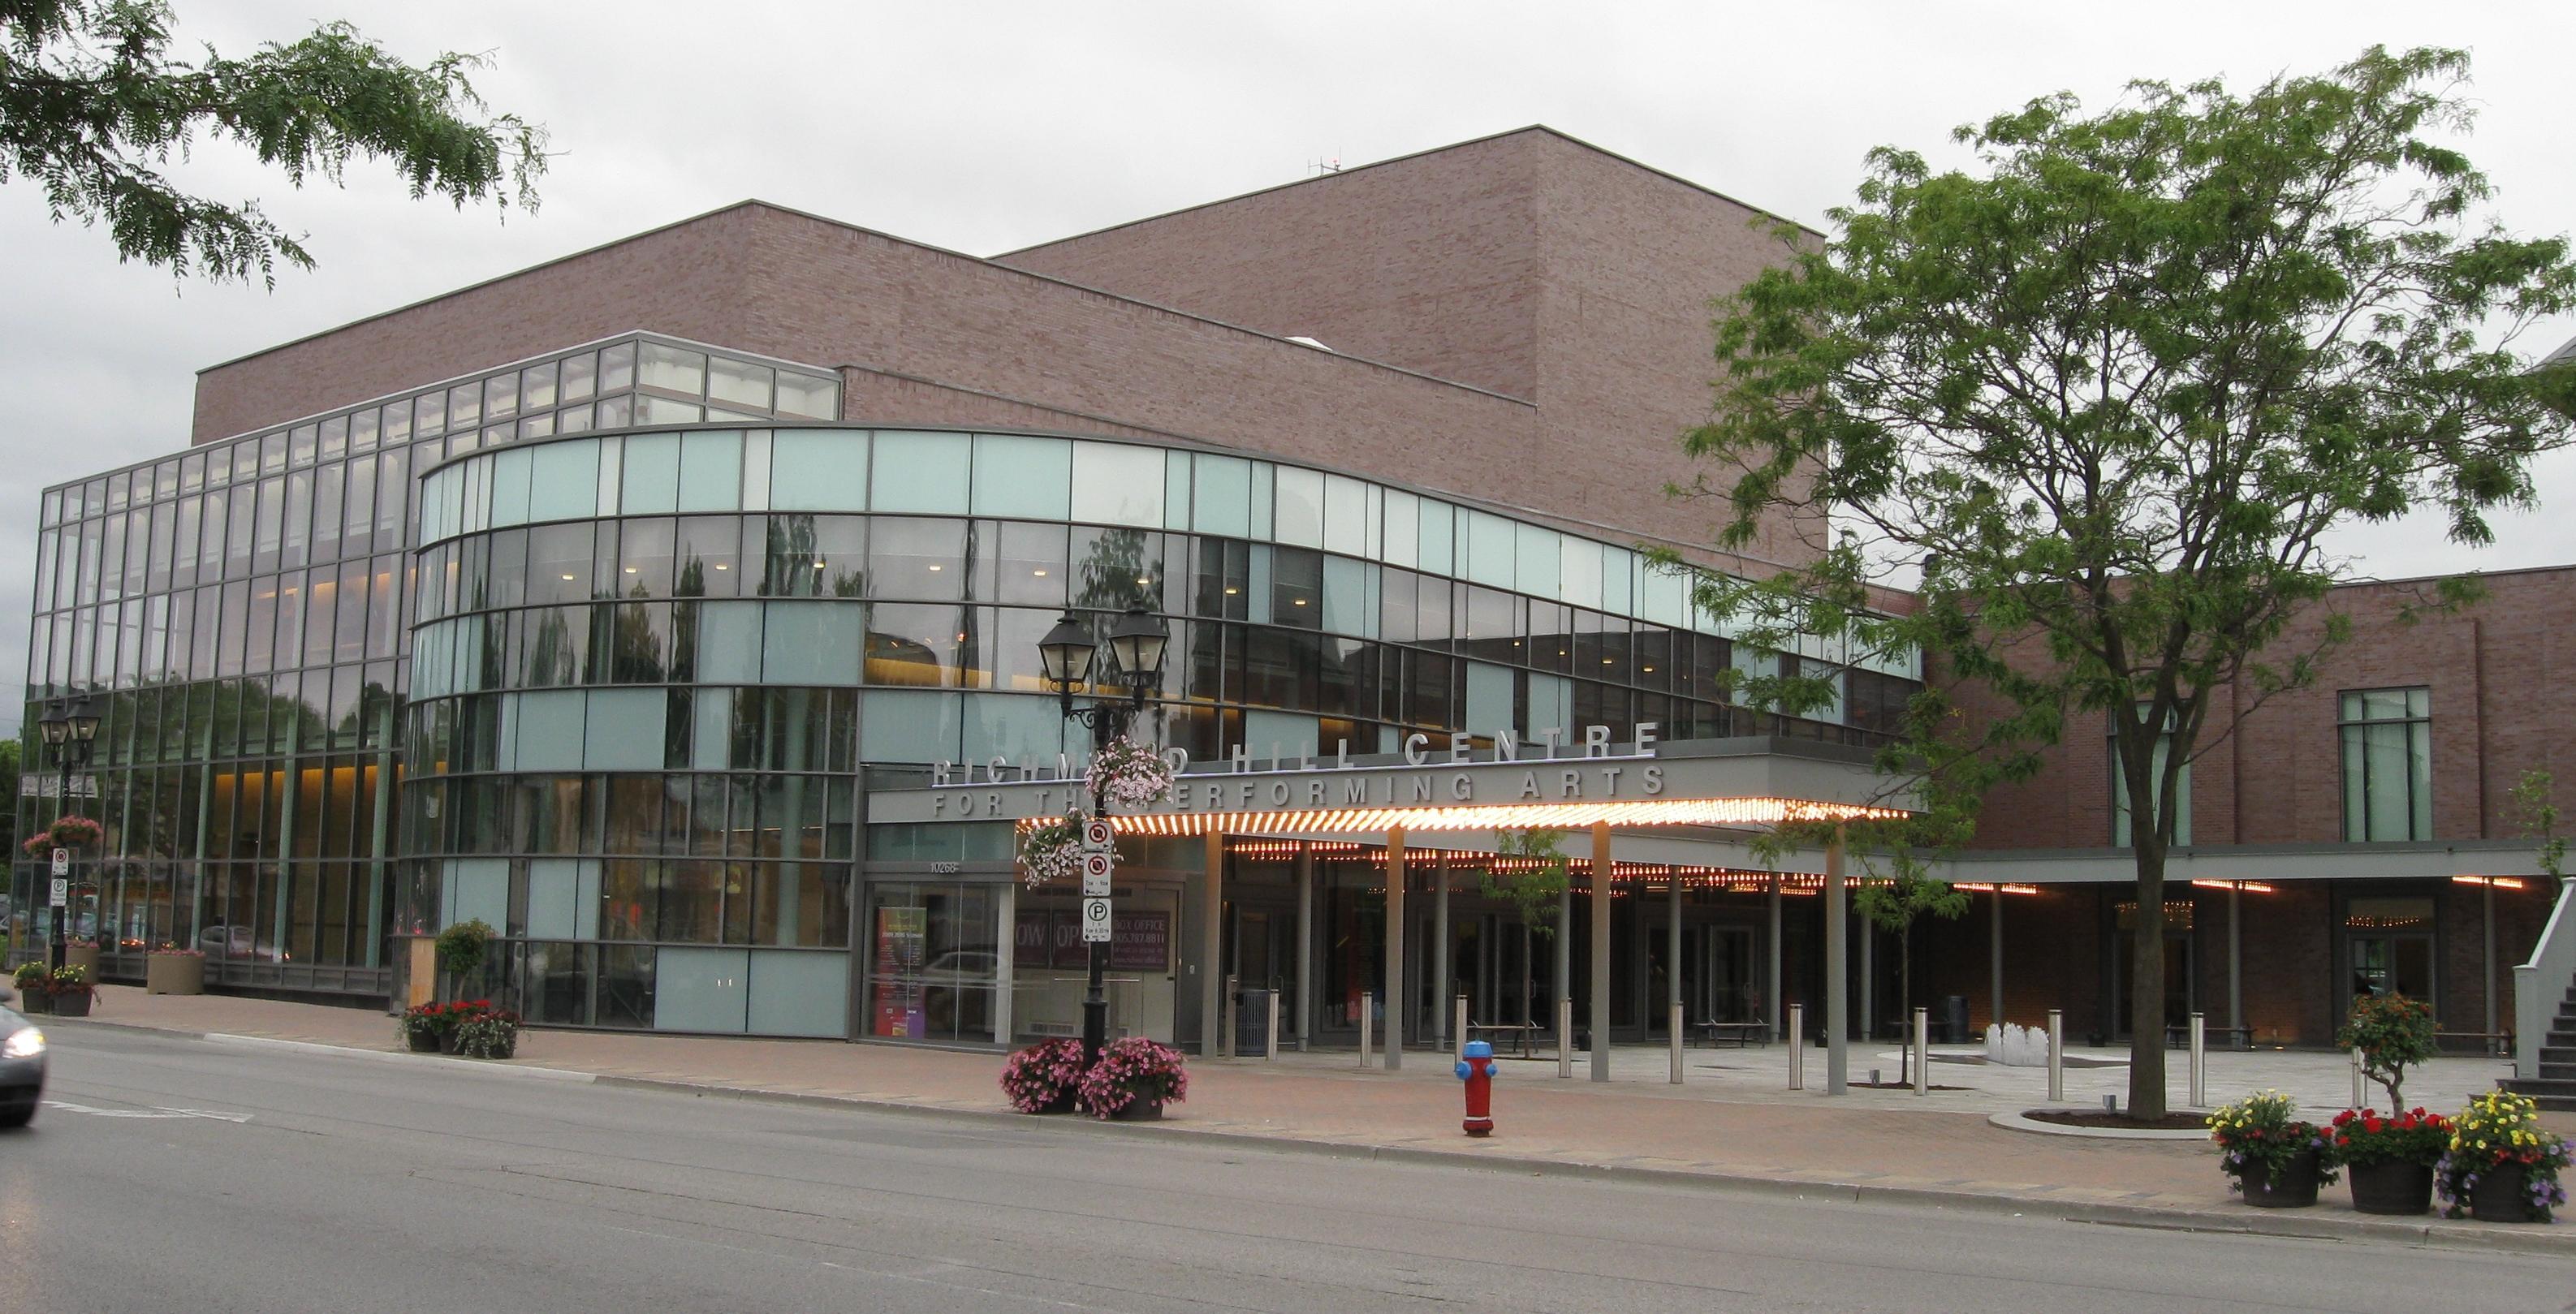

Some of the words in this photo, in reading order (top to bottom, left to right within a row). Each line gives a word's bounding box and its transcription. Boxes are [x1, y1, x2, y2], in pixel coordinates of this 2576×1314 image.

[933, 747, 1189, 786] RICHMD
[1232, 739, 1354, 773] HILL
[1405, 722, 1659, 765] CENTRE
[934, 791, 1003, 817] FOR
[1035, 787, 1079, 814] TH
[1147, 773, 1473, 810] ERFORMING
[1520, 765, 1663, 799] ARTS
[930, 861, 956, 873] 10268
[1016, 922, 1047, 946] OW
[1057, 924, 1089, 948] OPE
[1134, 920, 1165, 930] OFFICE
